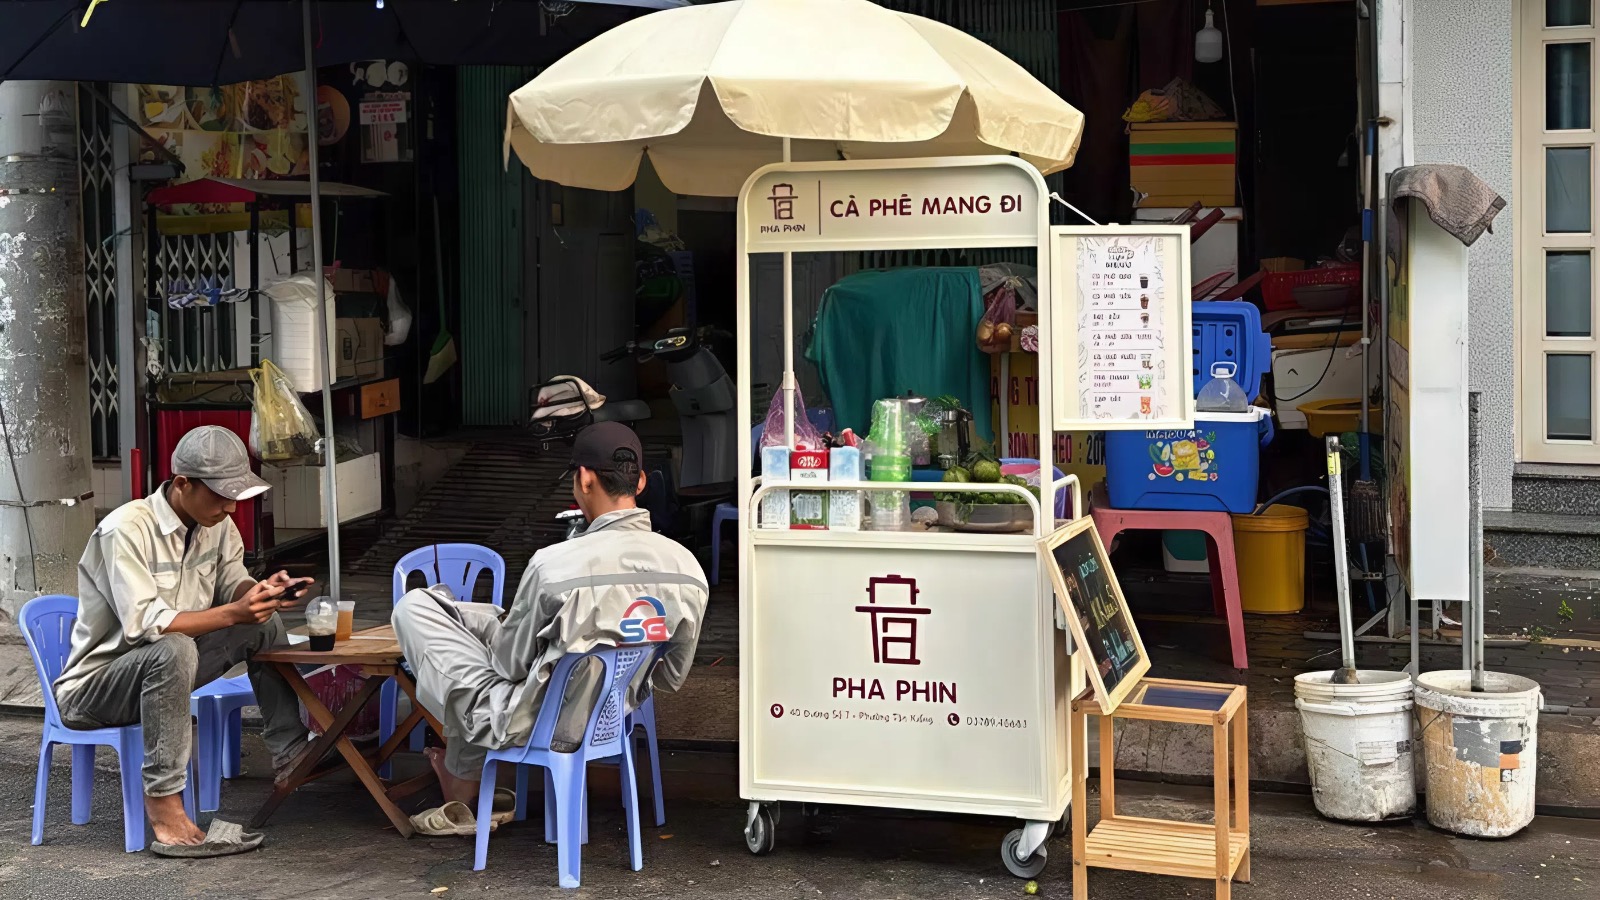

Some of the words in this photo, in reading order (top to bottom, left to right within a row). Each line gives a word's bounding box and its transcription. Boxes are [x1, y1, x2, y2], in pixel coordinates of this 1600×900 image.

[829, 194, 860, 218] CÀ
[921, 195, 992, 215] MANG
[1000, 194, 1022, 213] ĐI
[832, 677, 885, 700] PHA
[896, 679, 957, 704] PHIN
